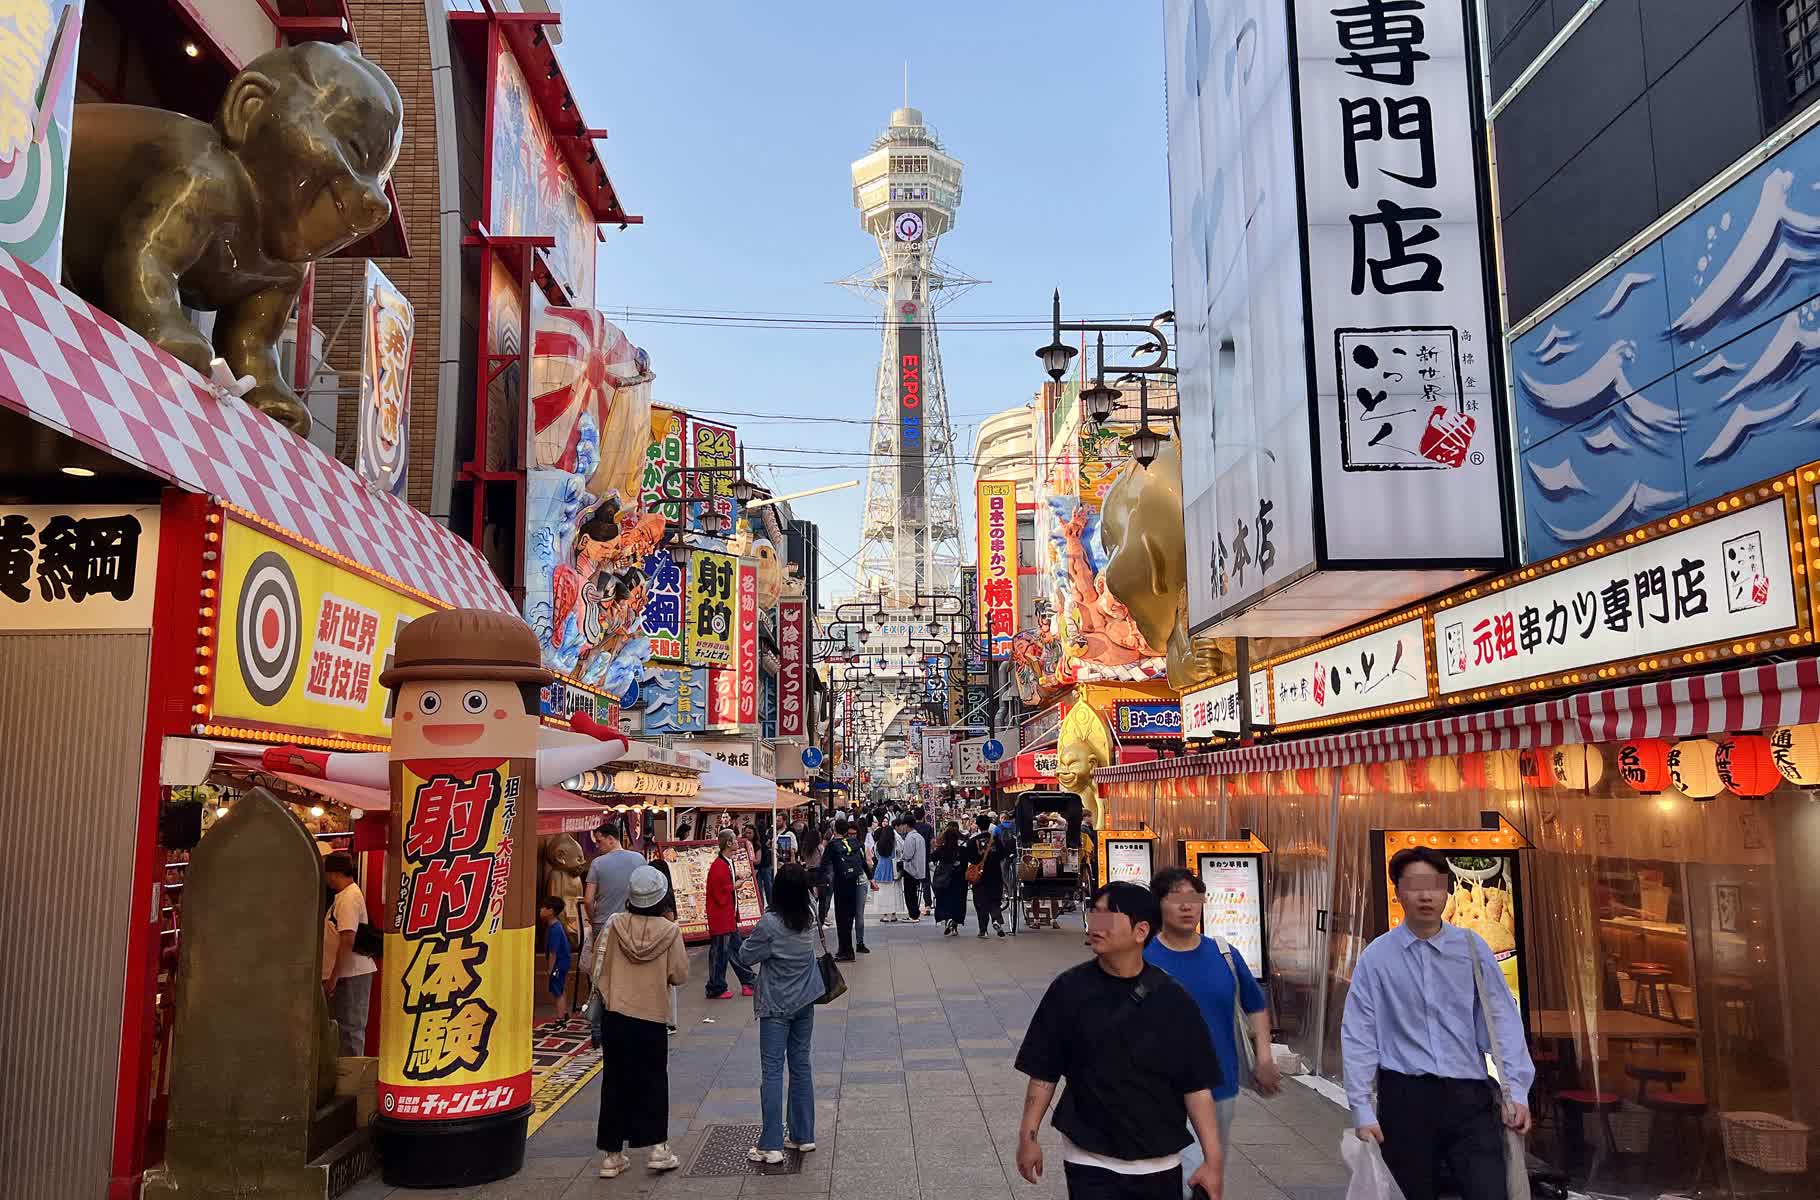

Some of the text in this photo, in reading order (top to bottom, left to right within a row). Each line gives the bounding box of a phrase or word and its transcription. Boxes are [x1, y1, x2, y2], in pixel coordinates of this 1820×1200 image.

[1330, 0, 1445, 296] 専門店
[902, 354, 920, 409] EXPO
[1416, 345, 1446, 402] 新世界
[697, 428, 734, 457] 24
[989, 496, 1006, 577] 日本一の串かつ
[642, 549, 680, 638] 横綱
[697, 556, 734, 641] 射的
[984, 578, 1014, 637] 横綱
[1473, 557, 1708, 667] 元祖串カツ専門店
[317, 600, 378, 655] 新世界
[306, 650, 371, 703] 遊技場
[1619, 745, 1646, 784] 名物
[1771, 729, 1802, 780] 通天閣
[421, 1086, 515, 1115] チャンピオン
